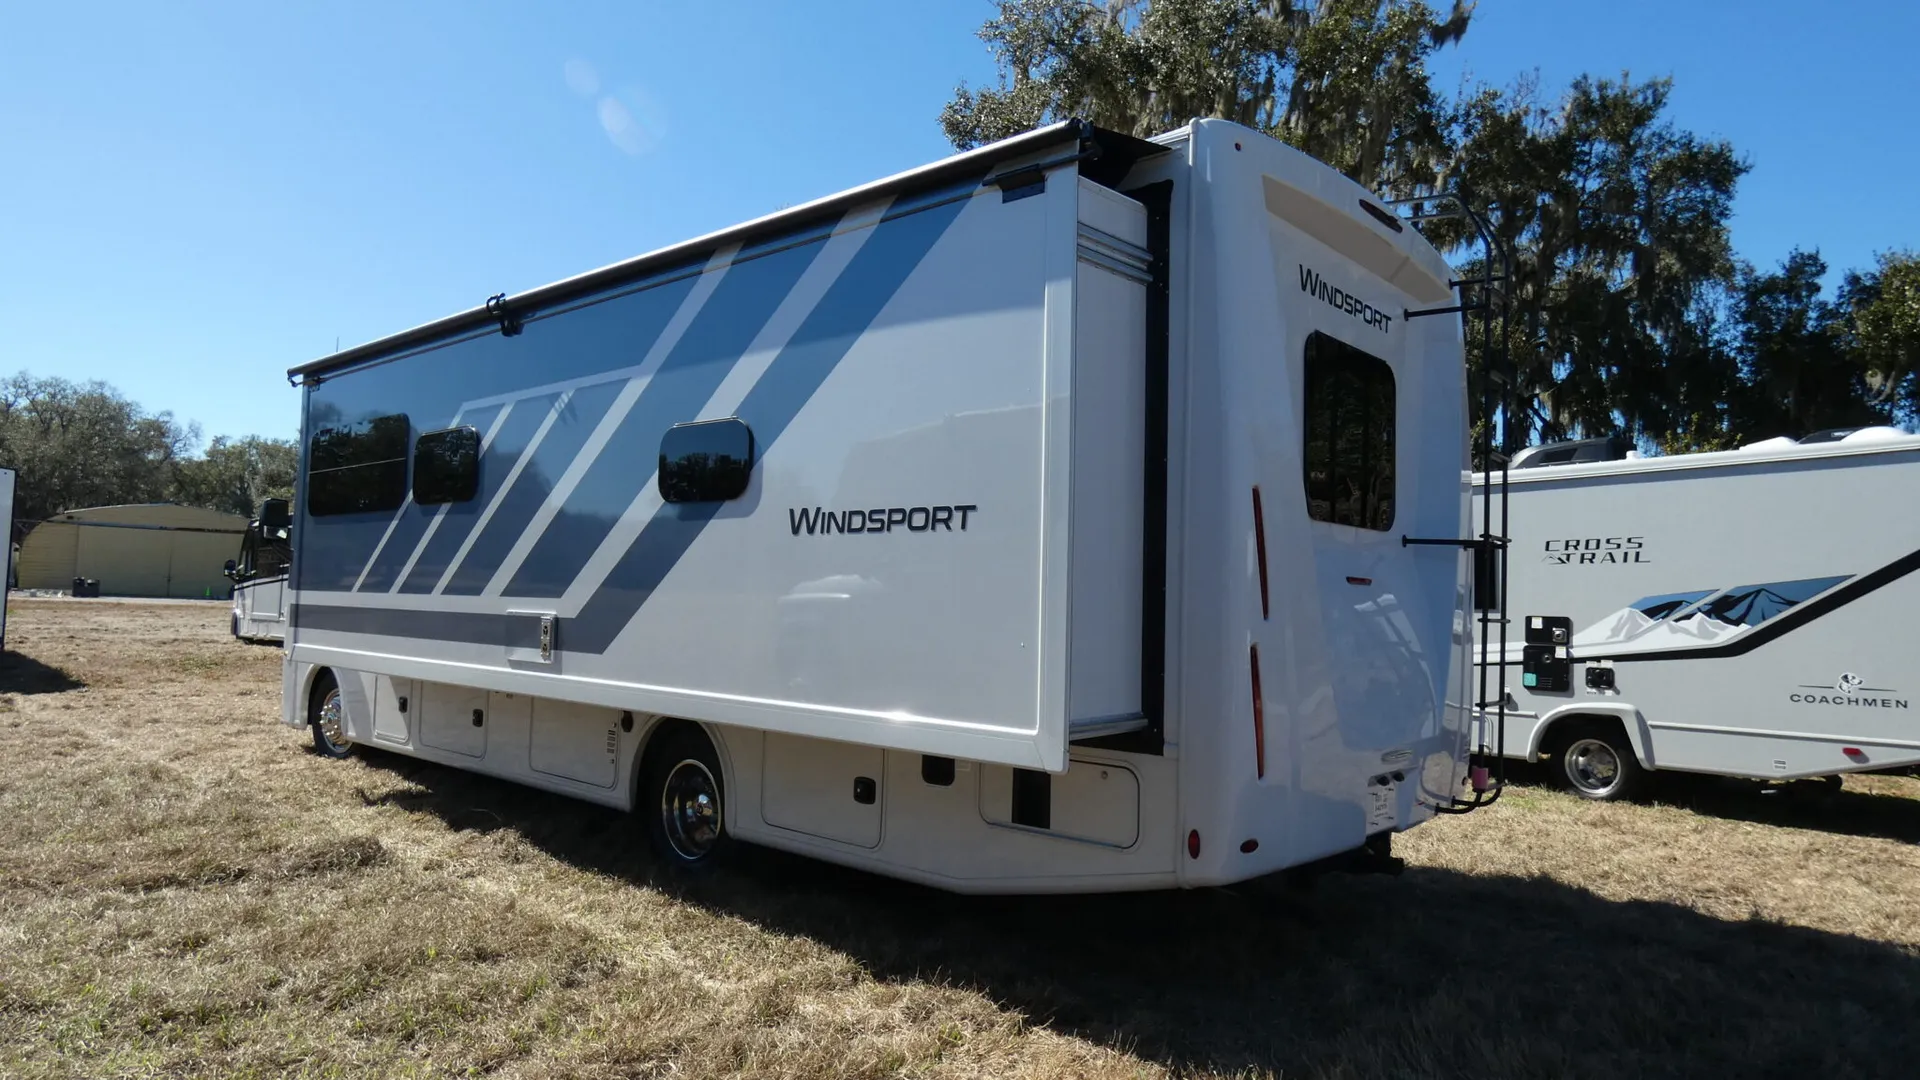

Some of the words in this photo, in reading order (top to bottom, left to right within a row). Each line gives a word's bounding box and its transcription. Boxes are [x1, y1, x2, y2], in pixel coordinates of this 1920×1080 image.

[1299, 263, 1392, 334] WINDSPORT
[788, 504, 977, 535] WINDSPORT
[1545, 536, 1644, 552] CROSS
[1558, 551, 1651, 564] TRAIL
[1790, 693, 1908, 709] COACHMEN
